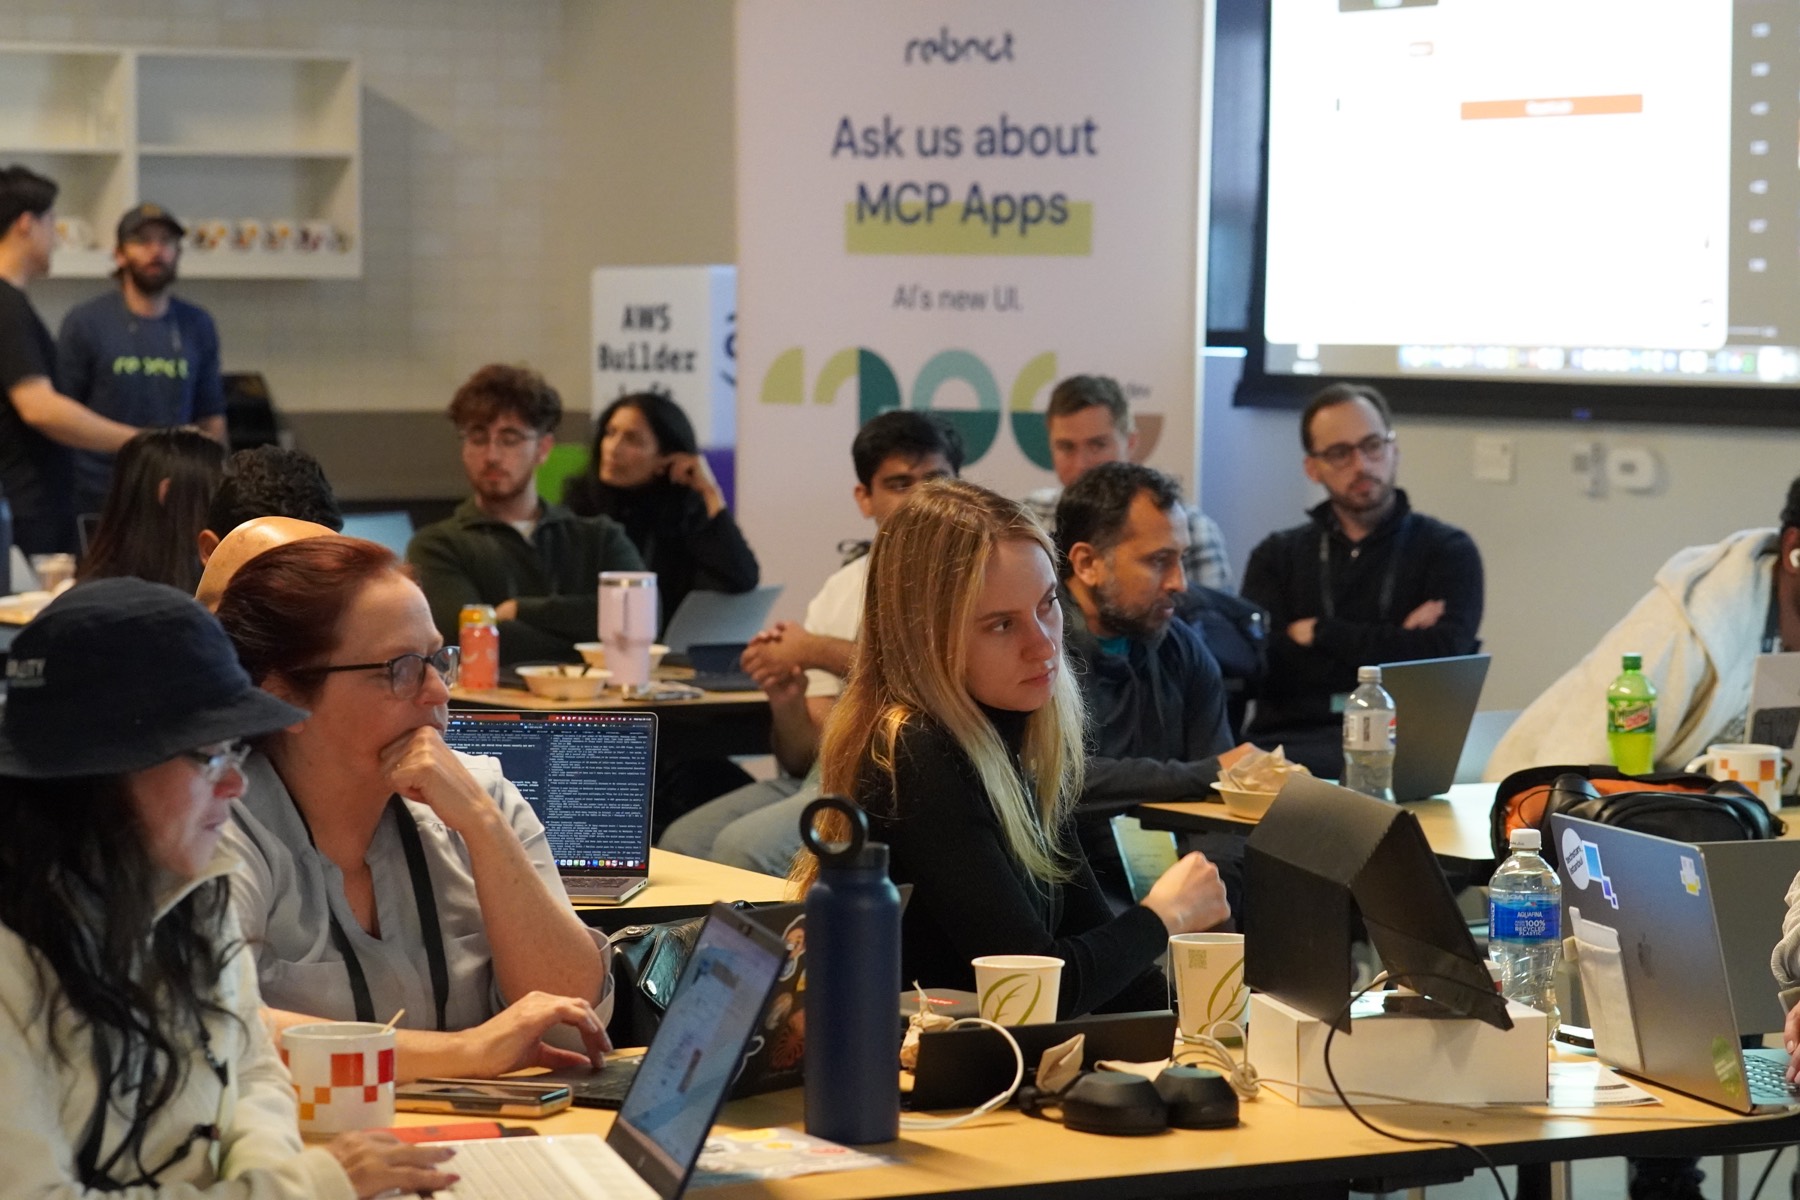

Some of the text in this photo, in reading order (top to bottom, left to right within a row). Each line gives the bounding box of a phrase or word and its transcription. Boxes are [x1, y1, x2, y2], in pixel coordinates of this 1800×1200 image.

[831, 114, 1099, 159] Ask us about
[857, 182, 1069, 236] MCP Apps
[892, 284, 933, 311] AI's
[937, 290, 988, 311] new
[621, 304, 672, 332] AWS
[598, 342, 696, 372] Builder
